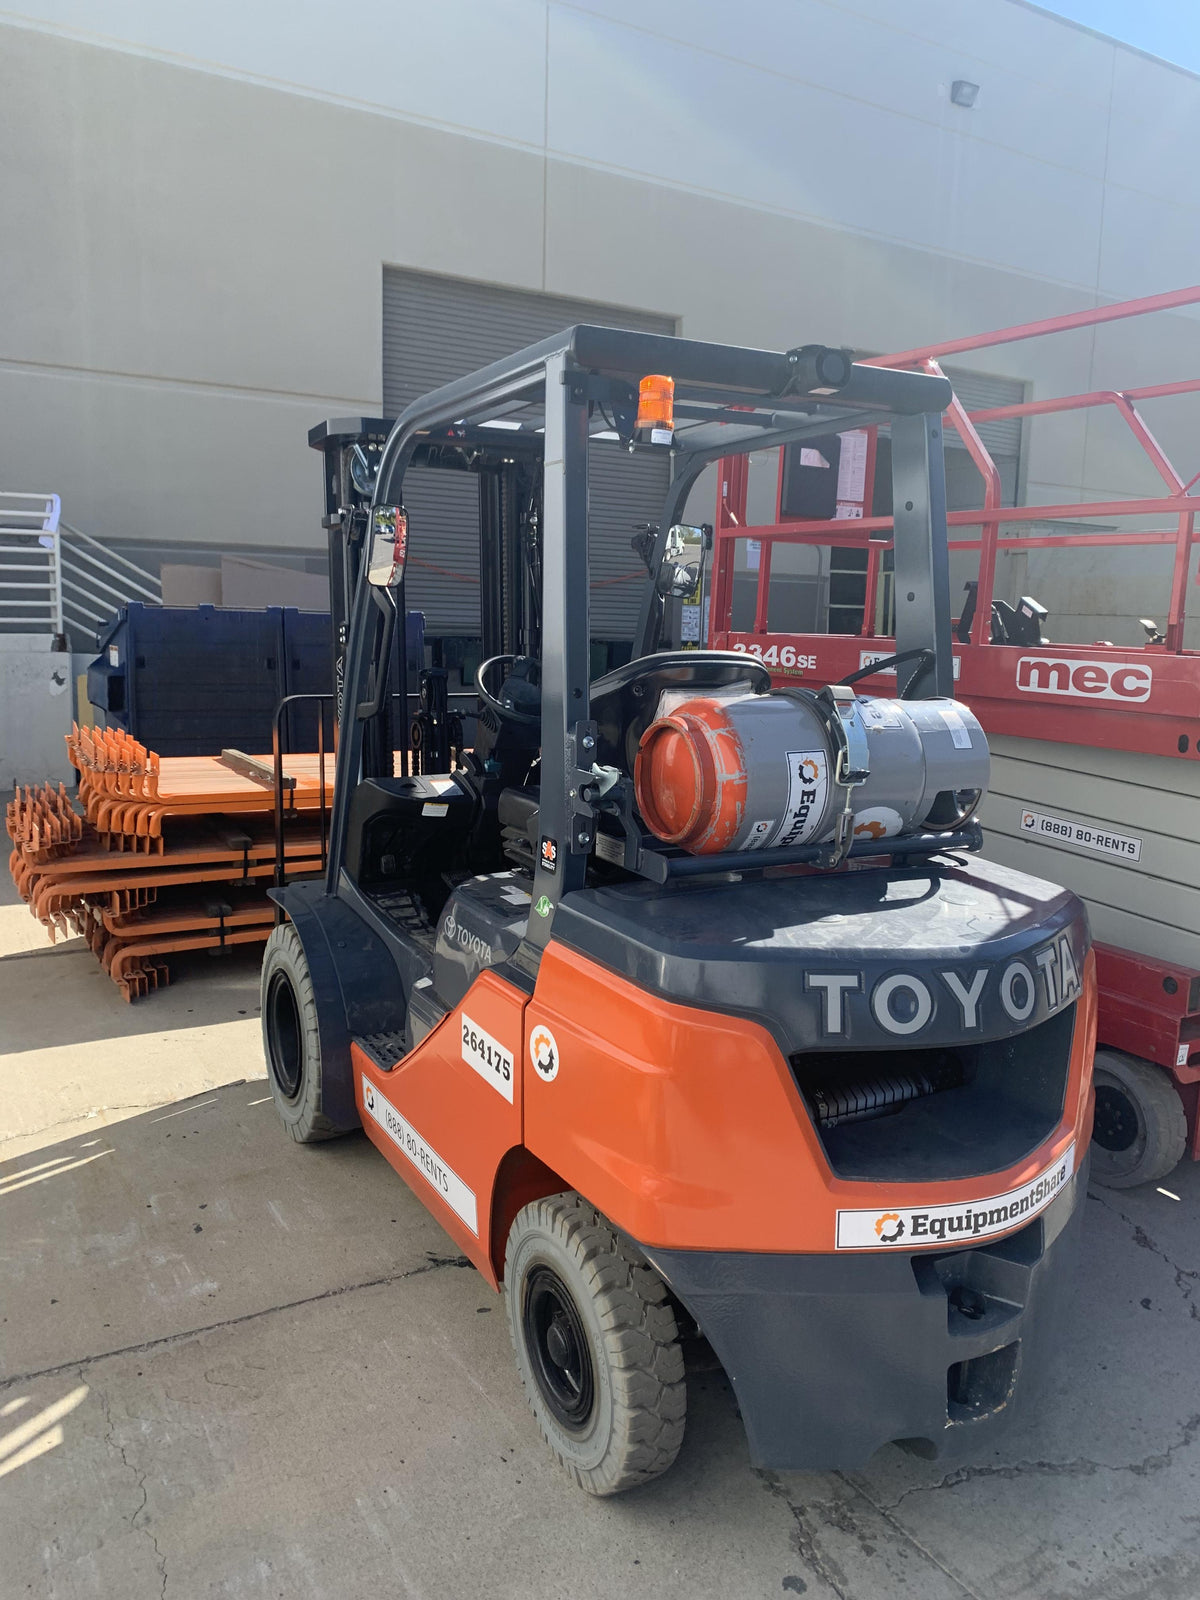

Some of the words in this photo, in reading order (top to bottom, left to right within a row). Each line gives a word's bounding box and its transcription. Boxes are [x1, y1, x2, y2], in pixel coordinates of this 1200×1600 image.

[1018, 660, 1150, 698] mec
[778, 788, 817, 847] Equip
[1040, 819, 1072, 838] (888)
[1075, 829, 1136, 854] 80-RENTS
[541, 840, 557, 860] SAS
[457, 924, 491, 964] TOYOTA
[808, 937, 1082, 1035] TOYOTA
[462, 1024, 511, 1081] 264175
[385, 1108, 405, 1145] (888)
[406, 1132, 449, 1193] 80-RENTS
[910, 1164, 1067, 1240] EquipmentShare
